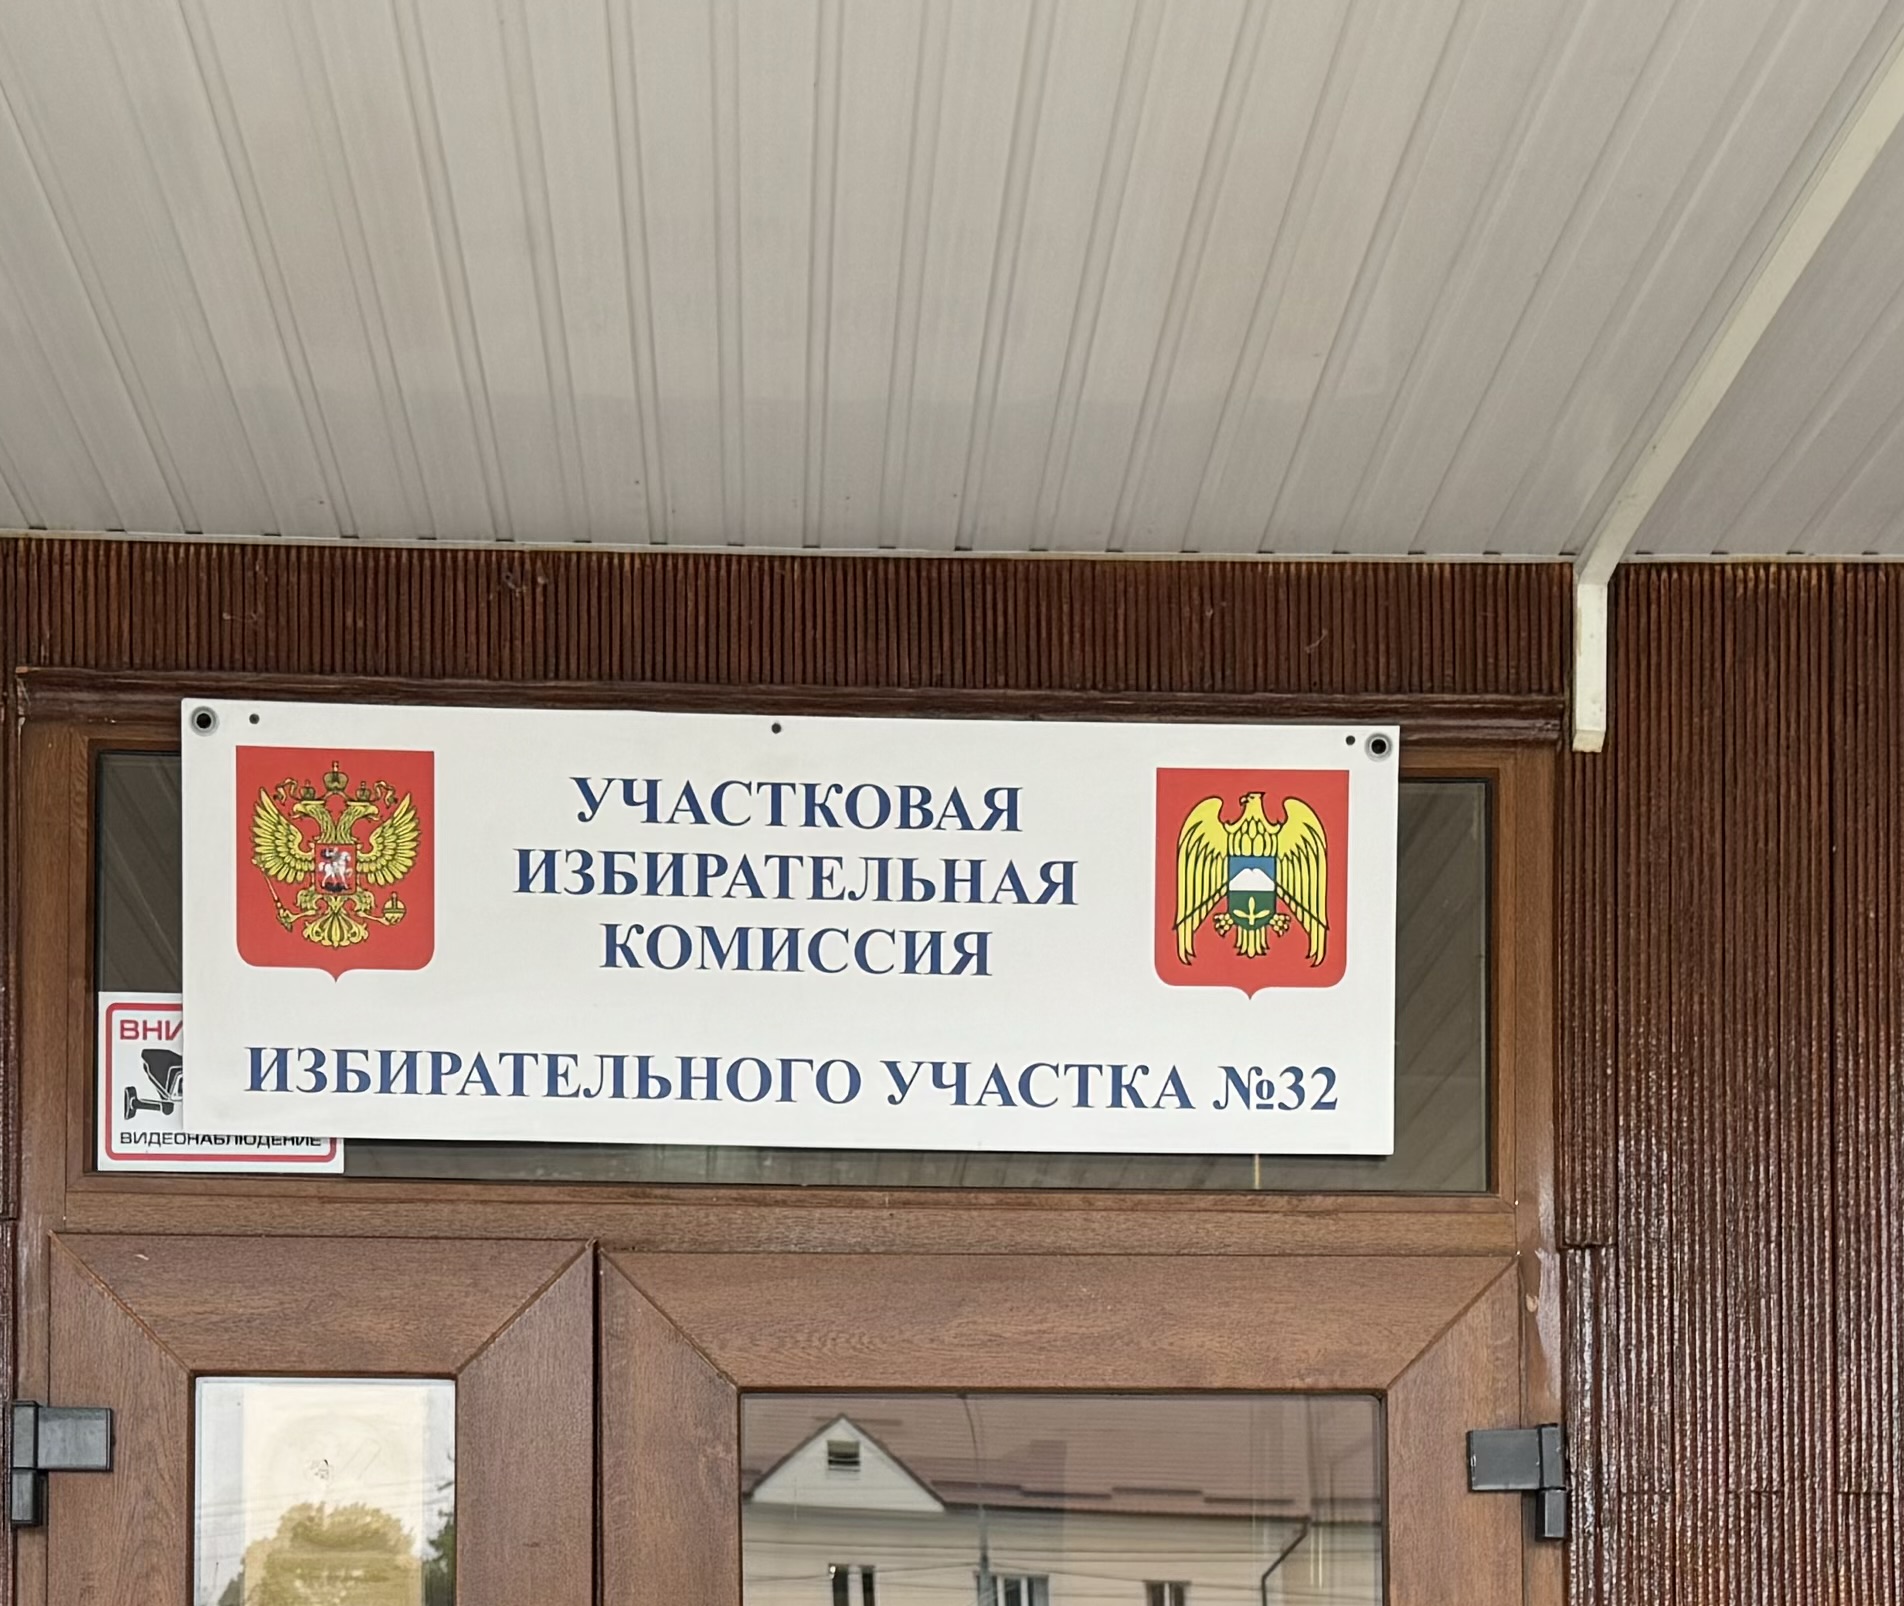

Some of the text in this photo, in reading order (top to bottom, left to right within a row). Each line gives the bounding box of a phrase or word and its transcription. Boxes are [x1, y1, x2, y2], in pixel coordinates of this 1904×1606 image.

[573, 777, 1022, 832] УЧАСТКОВАЯ
[515, 849, 1077, 905] ИЗБИРАТЕЛЬНАЯ
[601, 925, 992, 976] КОМИССИЯ
[247, 1046, 1340, 1111] ИЗБИРАТЕЛЬНОГО УЧАСТКА №32
[120, 1132, 321, 1149] ВИДЕОНАБЛЮДЕНИЕ
